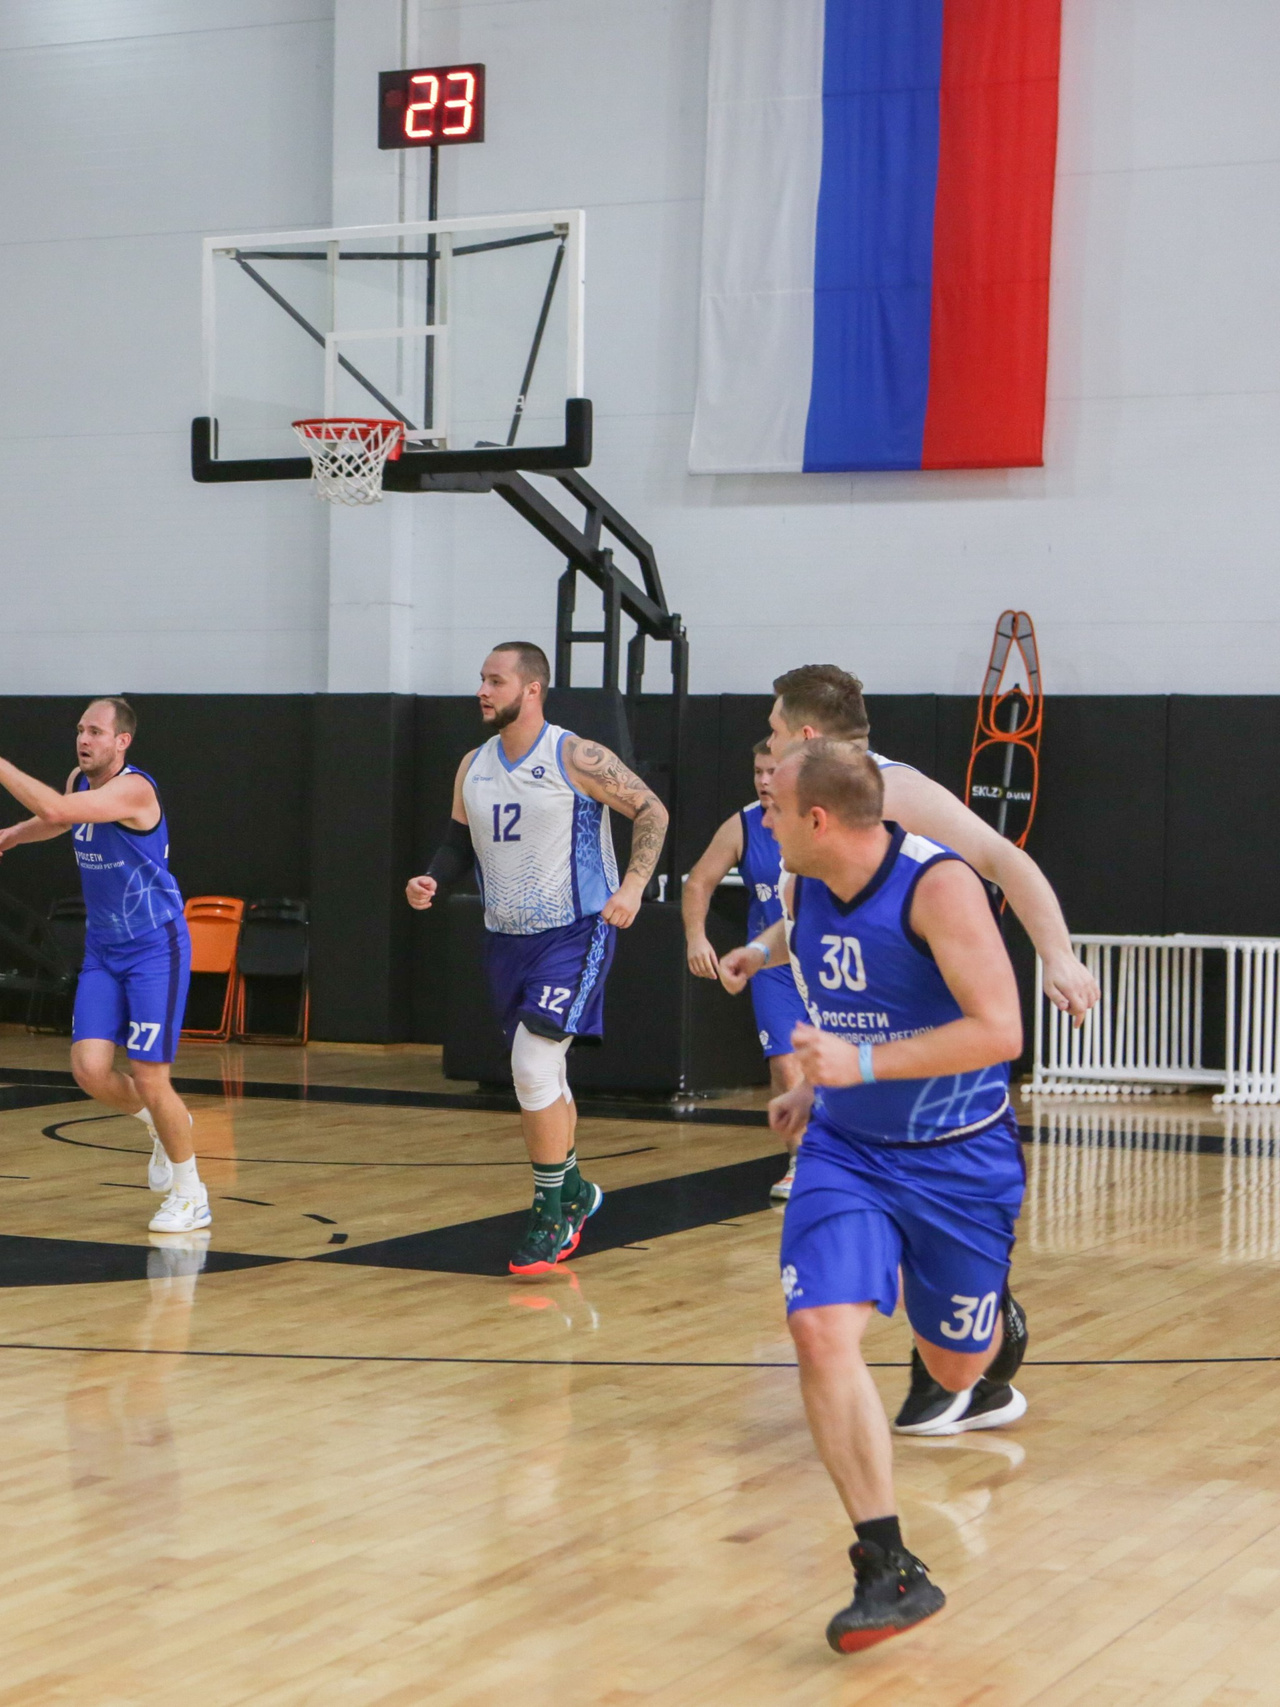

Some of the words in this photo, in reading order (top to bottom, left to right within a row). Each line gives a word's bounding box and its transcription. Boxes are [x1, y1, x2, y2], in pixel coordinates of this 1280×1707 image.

[405, 72, 476, 138] 23
[972, 785, 998, 798] SKLZ
[493, 803, 521, 842] 12
[819, 934, 867, 991] 30
[538, 985, 571, 1015] 12
[127, 1021, 161, 1051] 27
[821, 1010, 889, 1028] РОССЕТИ
[940, 1291, 998, 1341] 30
